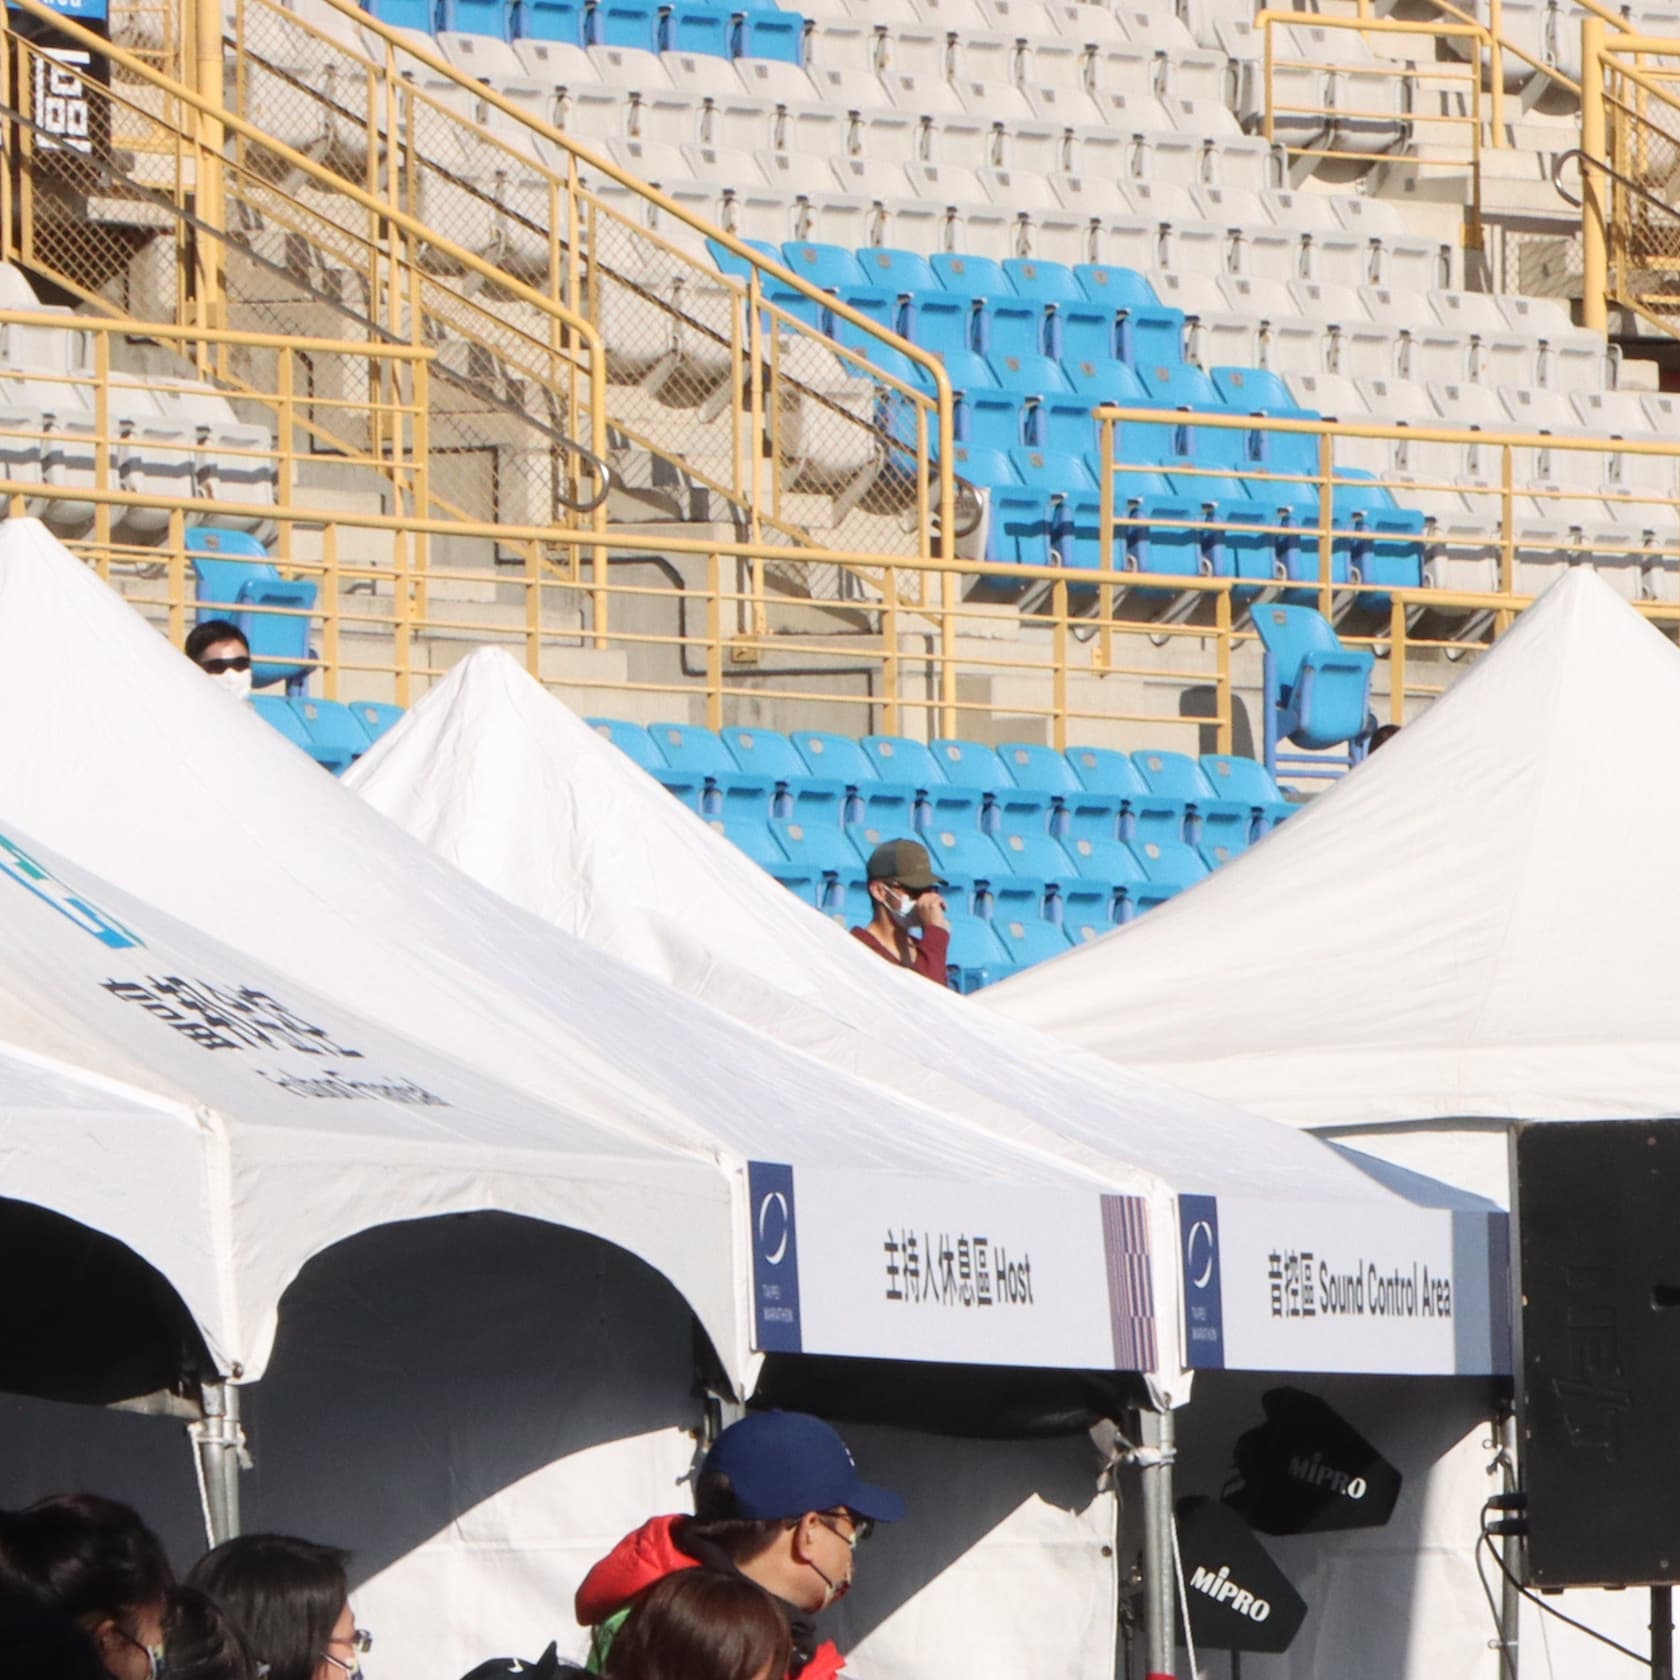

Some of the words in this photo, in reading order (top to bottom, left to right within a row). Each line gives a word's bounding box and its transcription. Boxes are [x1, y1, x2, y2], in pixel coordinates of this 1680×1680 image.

[884, 1229, 993, 1308] 主持人休息區
[994, 1247, 1034, 1306] Host
[1268, 1248, 1317, 1320] 音控區
[1319, 1256, 1364, 1317] Sound
[1367, 1259, 1418, 1318] Control
[1421, 1263, 1452, 1320] Area
